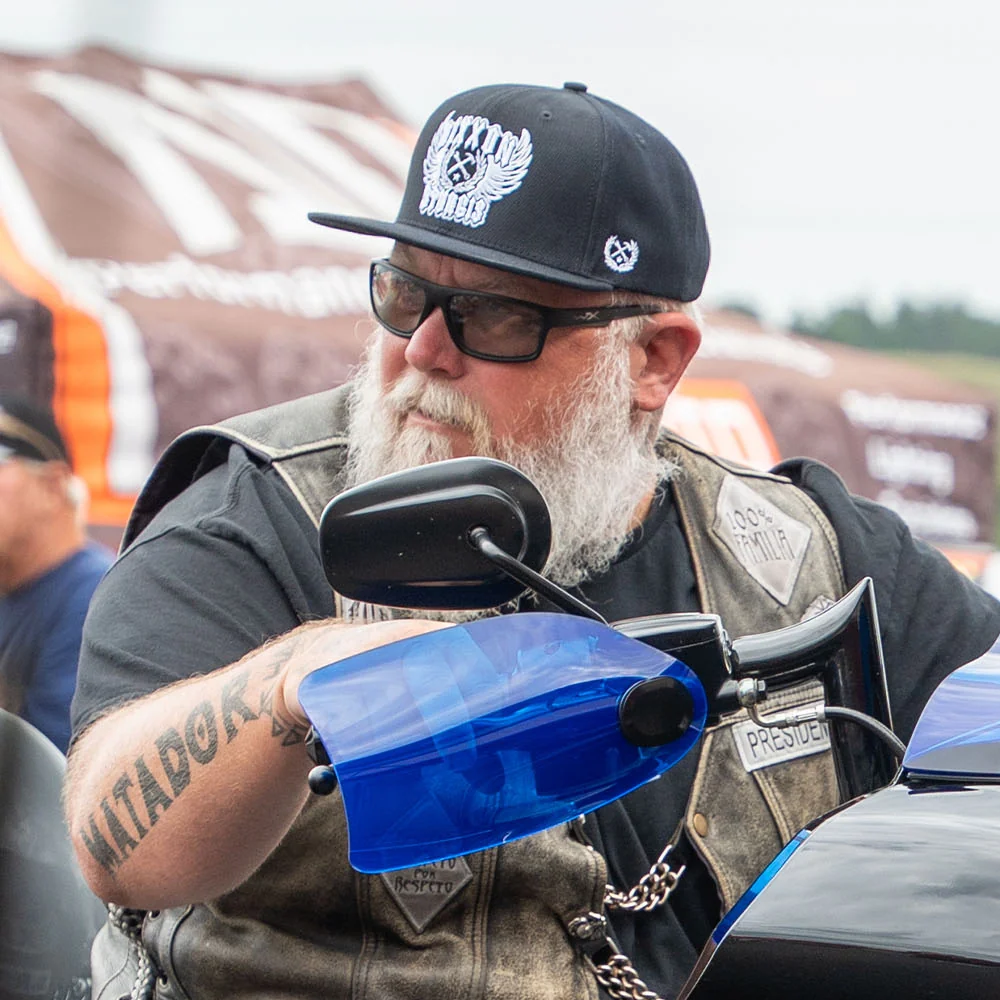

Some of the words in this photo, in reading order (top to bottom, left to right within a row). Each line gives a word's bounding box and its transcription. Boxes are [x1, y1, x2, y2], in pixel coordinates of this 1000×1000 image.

[726, 507, 773, 530] 100%
[733, 529, 796, 566] FAMILIA
[746, 720, 830, 758] PRESIDEN
[79, 671, 260, 879] MATADOR
